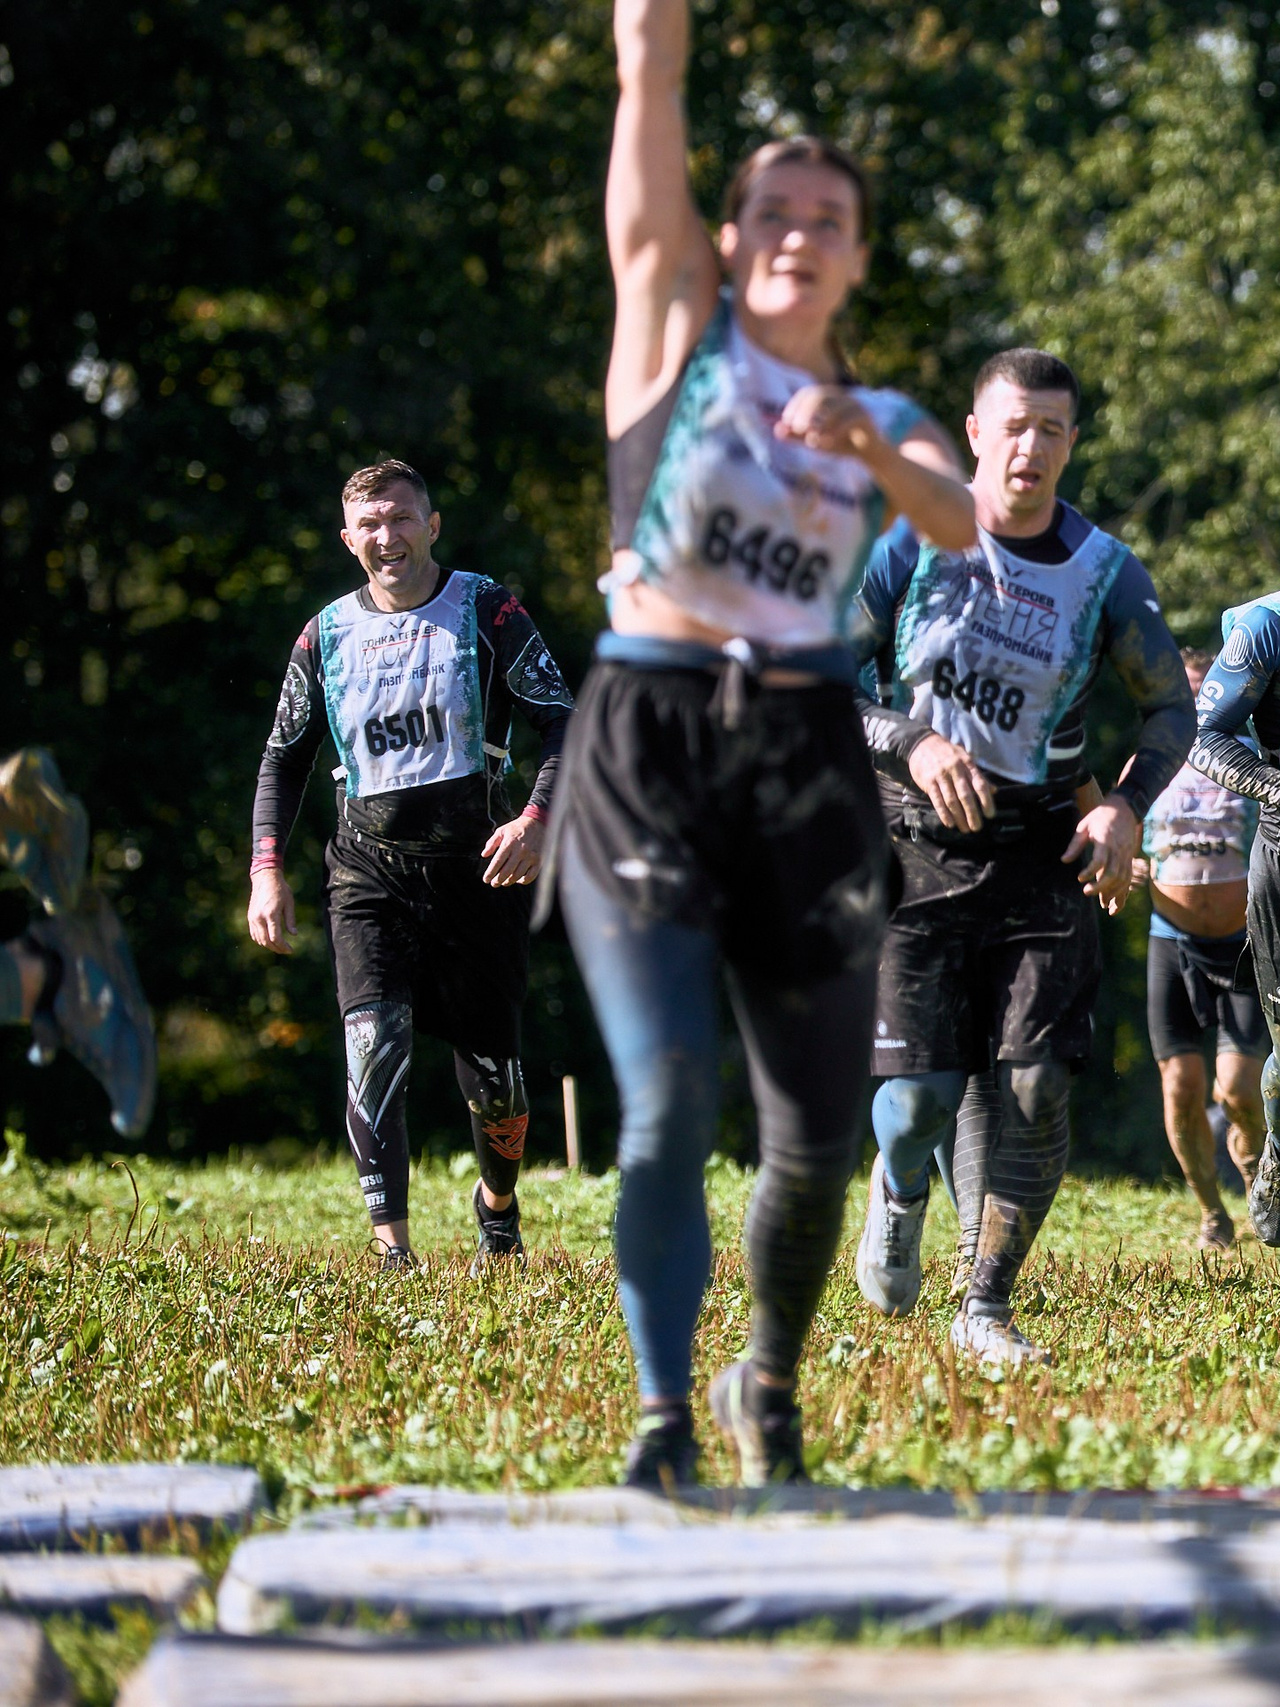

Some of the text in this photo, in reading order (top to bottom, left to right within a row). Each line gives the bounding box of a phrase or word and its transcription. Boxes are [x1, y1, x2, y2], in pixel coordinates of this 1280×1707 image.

[703, 504, 831, 604] 6496
[1007, 582, 1055, 608] ГЕРОЕВ
[361, 624, 438, 649] ГОНКА ГЕРЕВ
[971, 620, 1053, 664] ГАЗПРОМБАНК
[931, 656, 1025, 733] 6488
[363, 704, 445, 757] 6501
